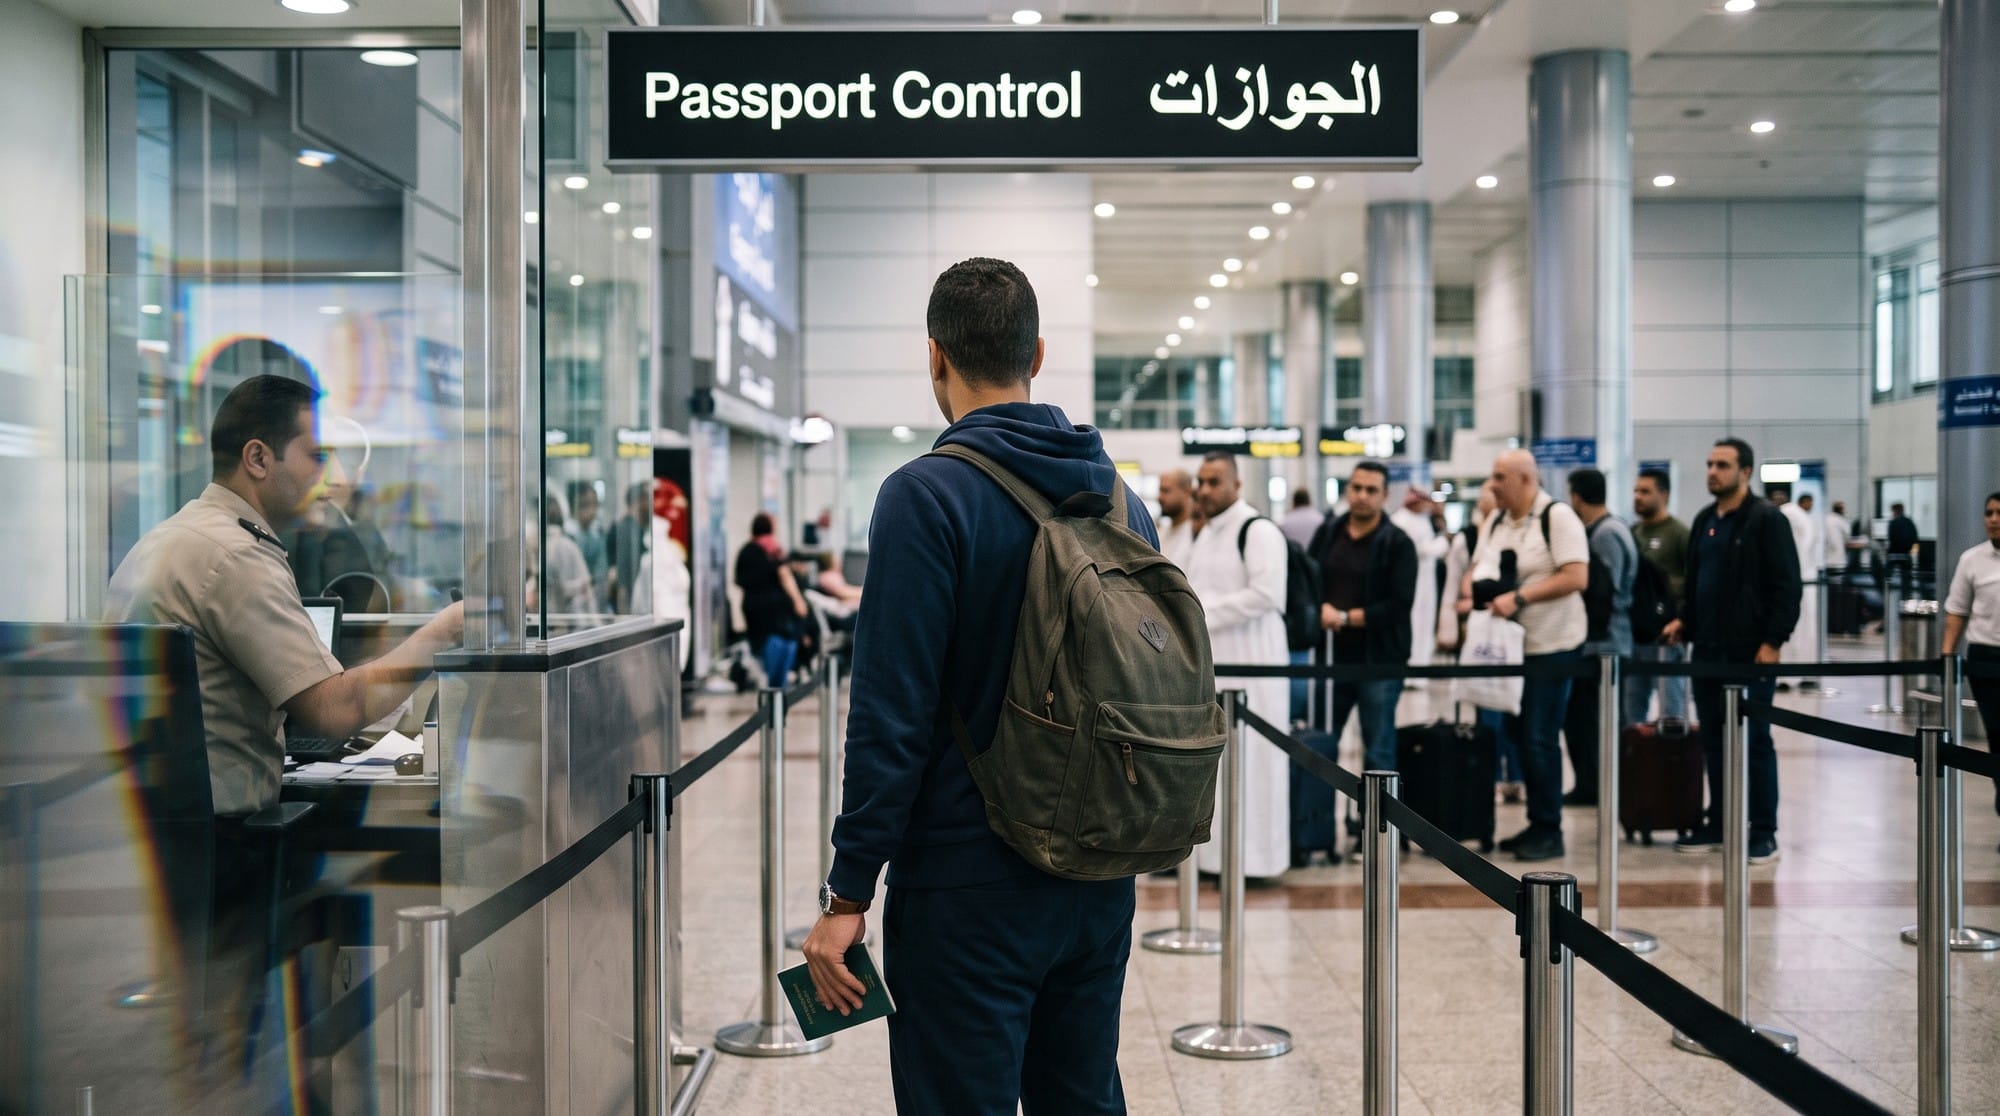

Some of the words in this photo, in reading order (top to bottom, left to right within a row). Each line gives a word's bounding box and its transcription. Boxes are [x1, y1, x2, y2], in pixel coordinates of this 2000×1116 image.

[645, 71, 877, 130] Passport
[892, 70, 1082, 119] Control
[1149, 60, 1381, 131] الجوازات
